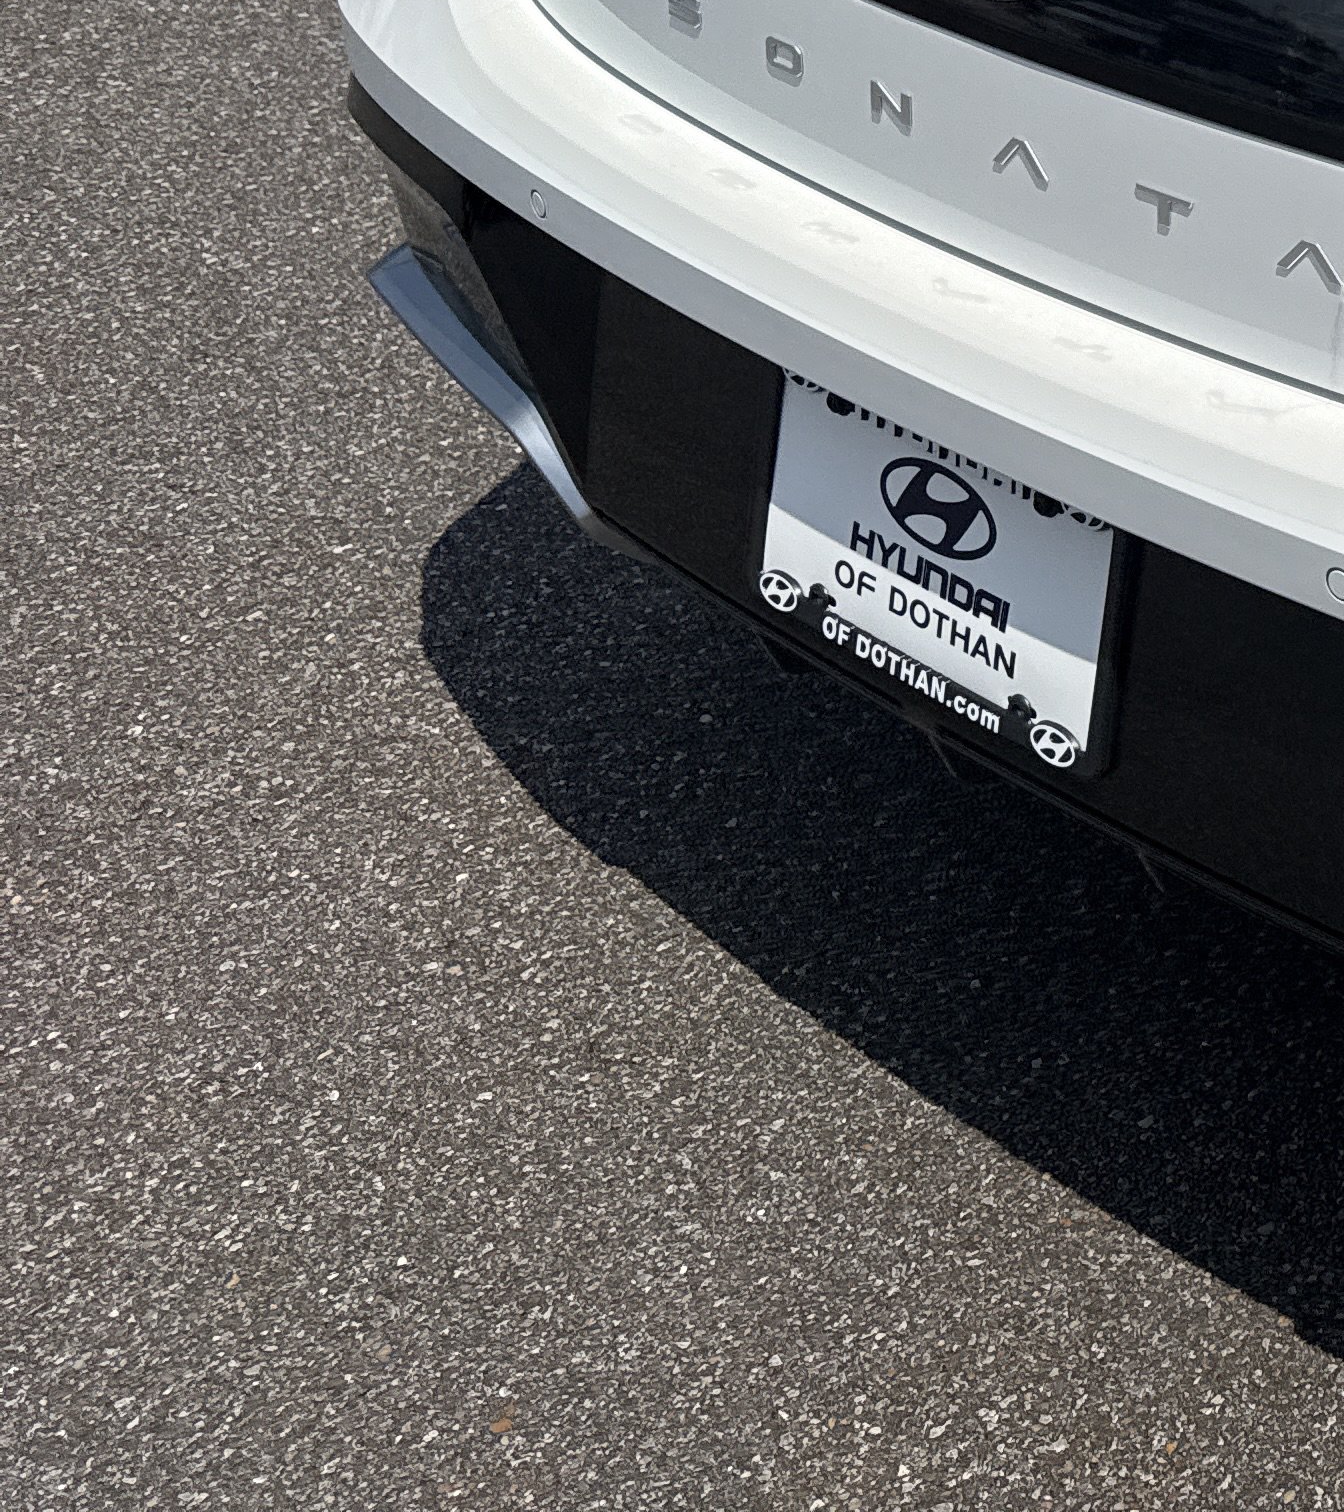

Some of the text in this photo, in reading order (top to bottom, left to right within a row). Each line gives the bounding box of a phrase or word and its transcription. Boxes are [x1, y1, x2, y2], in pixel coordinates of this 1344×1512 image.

[834, 559, 1017, 680] OF DOTHAN
[850, 520, 1011, 634] HYUNDAI
[822, 615, 1001, 734] OF DOTHAN.com
